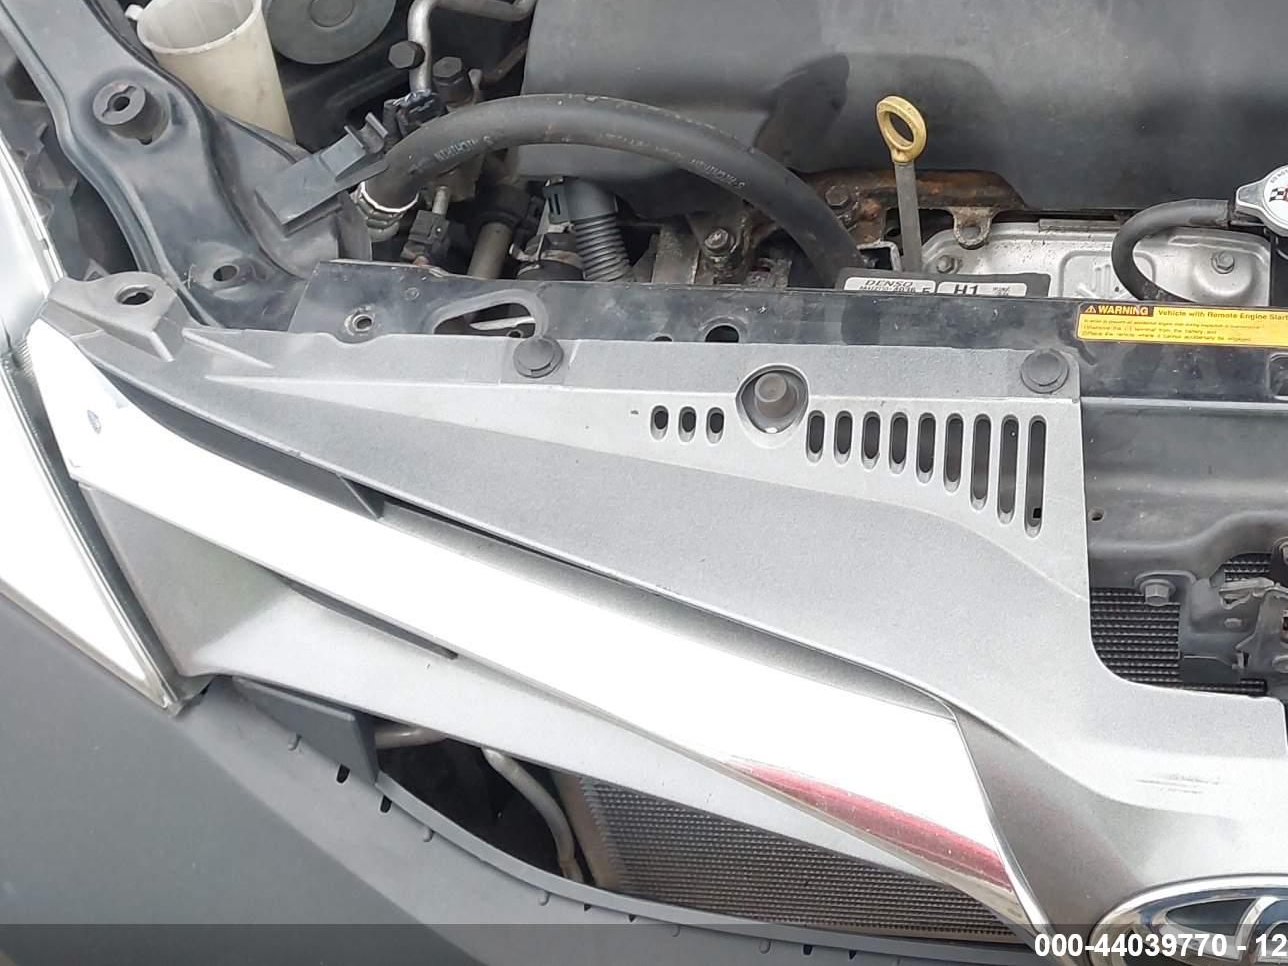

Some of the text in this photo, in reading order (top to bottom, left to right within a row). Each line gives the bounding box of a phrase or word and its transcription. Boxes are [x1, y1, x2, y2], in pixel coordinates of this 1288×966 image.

[953, 283, 979, 296] H1
[1098, 305, 1149, 316] WARNING
[1158, 309, 1187, 317] Vehicle
[1207, 311, 1238, 319] Remote
[1239, 312, 1267, 321] Engine
